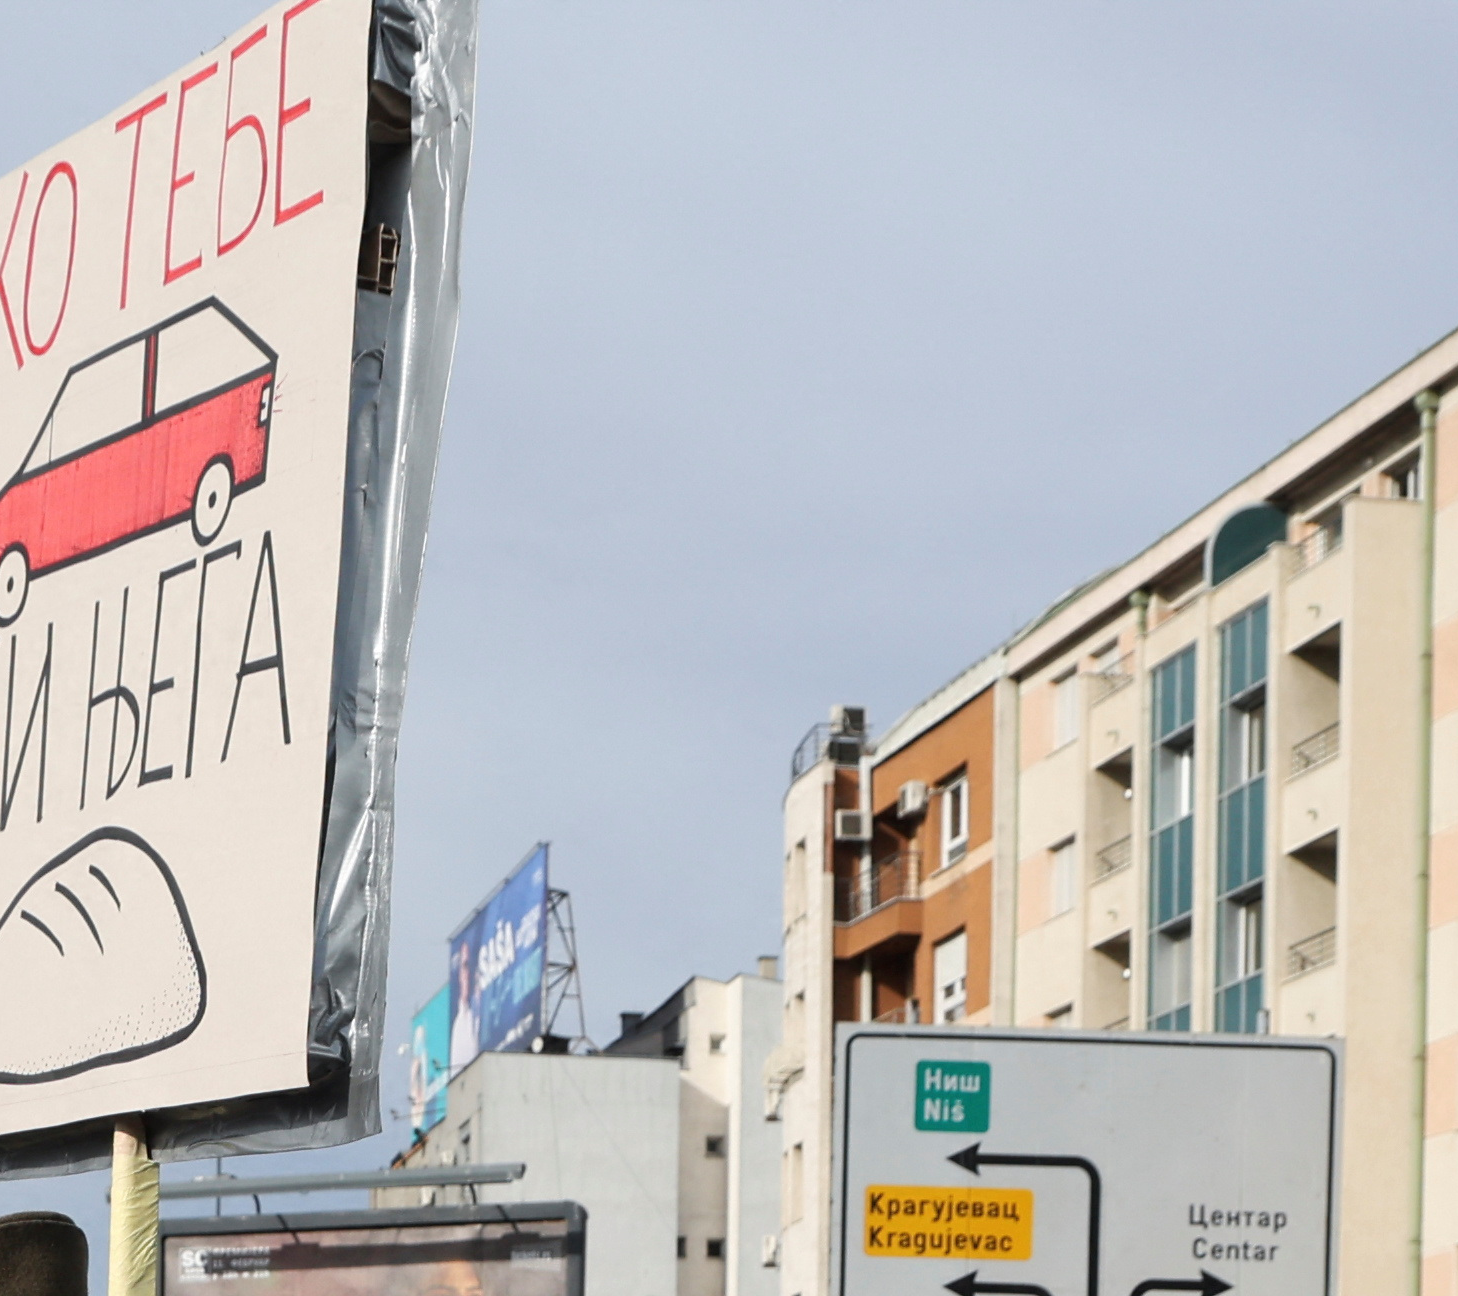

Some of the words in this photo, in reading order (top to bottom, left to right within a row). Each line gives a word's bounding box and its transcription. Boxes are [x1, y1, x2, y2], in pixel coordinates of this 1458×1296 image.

[115, 0, 323, 311] ТЕБЕ
[80, 530, 290, 811] ЊЕГА
[924, 1068, 980, 1092] Ниш
[923, 1098, 965, 1122] Niš
[869, 1193, 1019, 1223] Крагујевац
[1188, 1203, 1287, 1233] Центар
[869, 1226, 1014, 1255] Kragujevac
[1193, 1237, 1279, 1261] Centar
